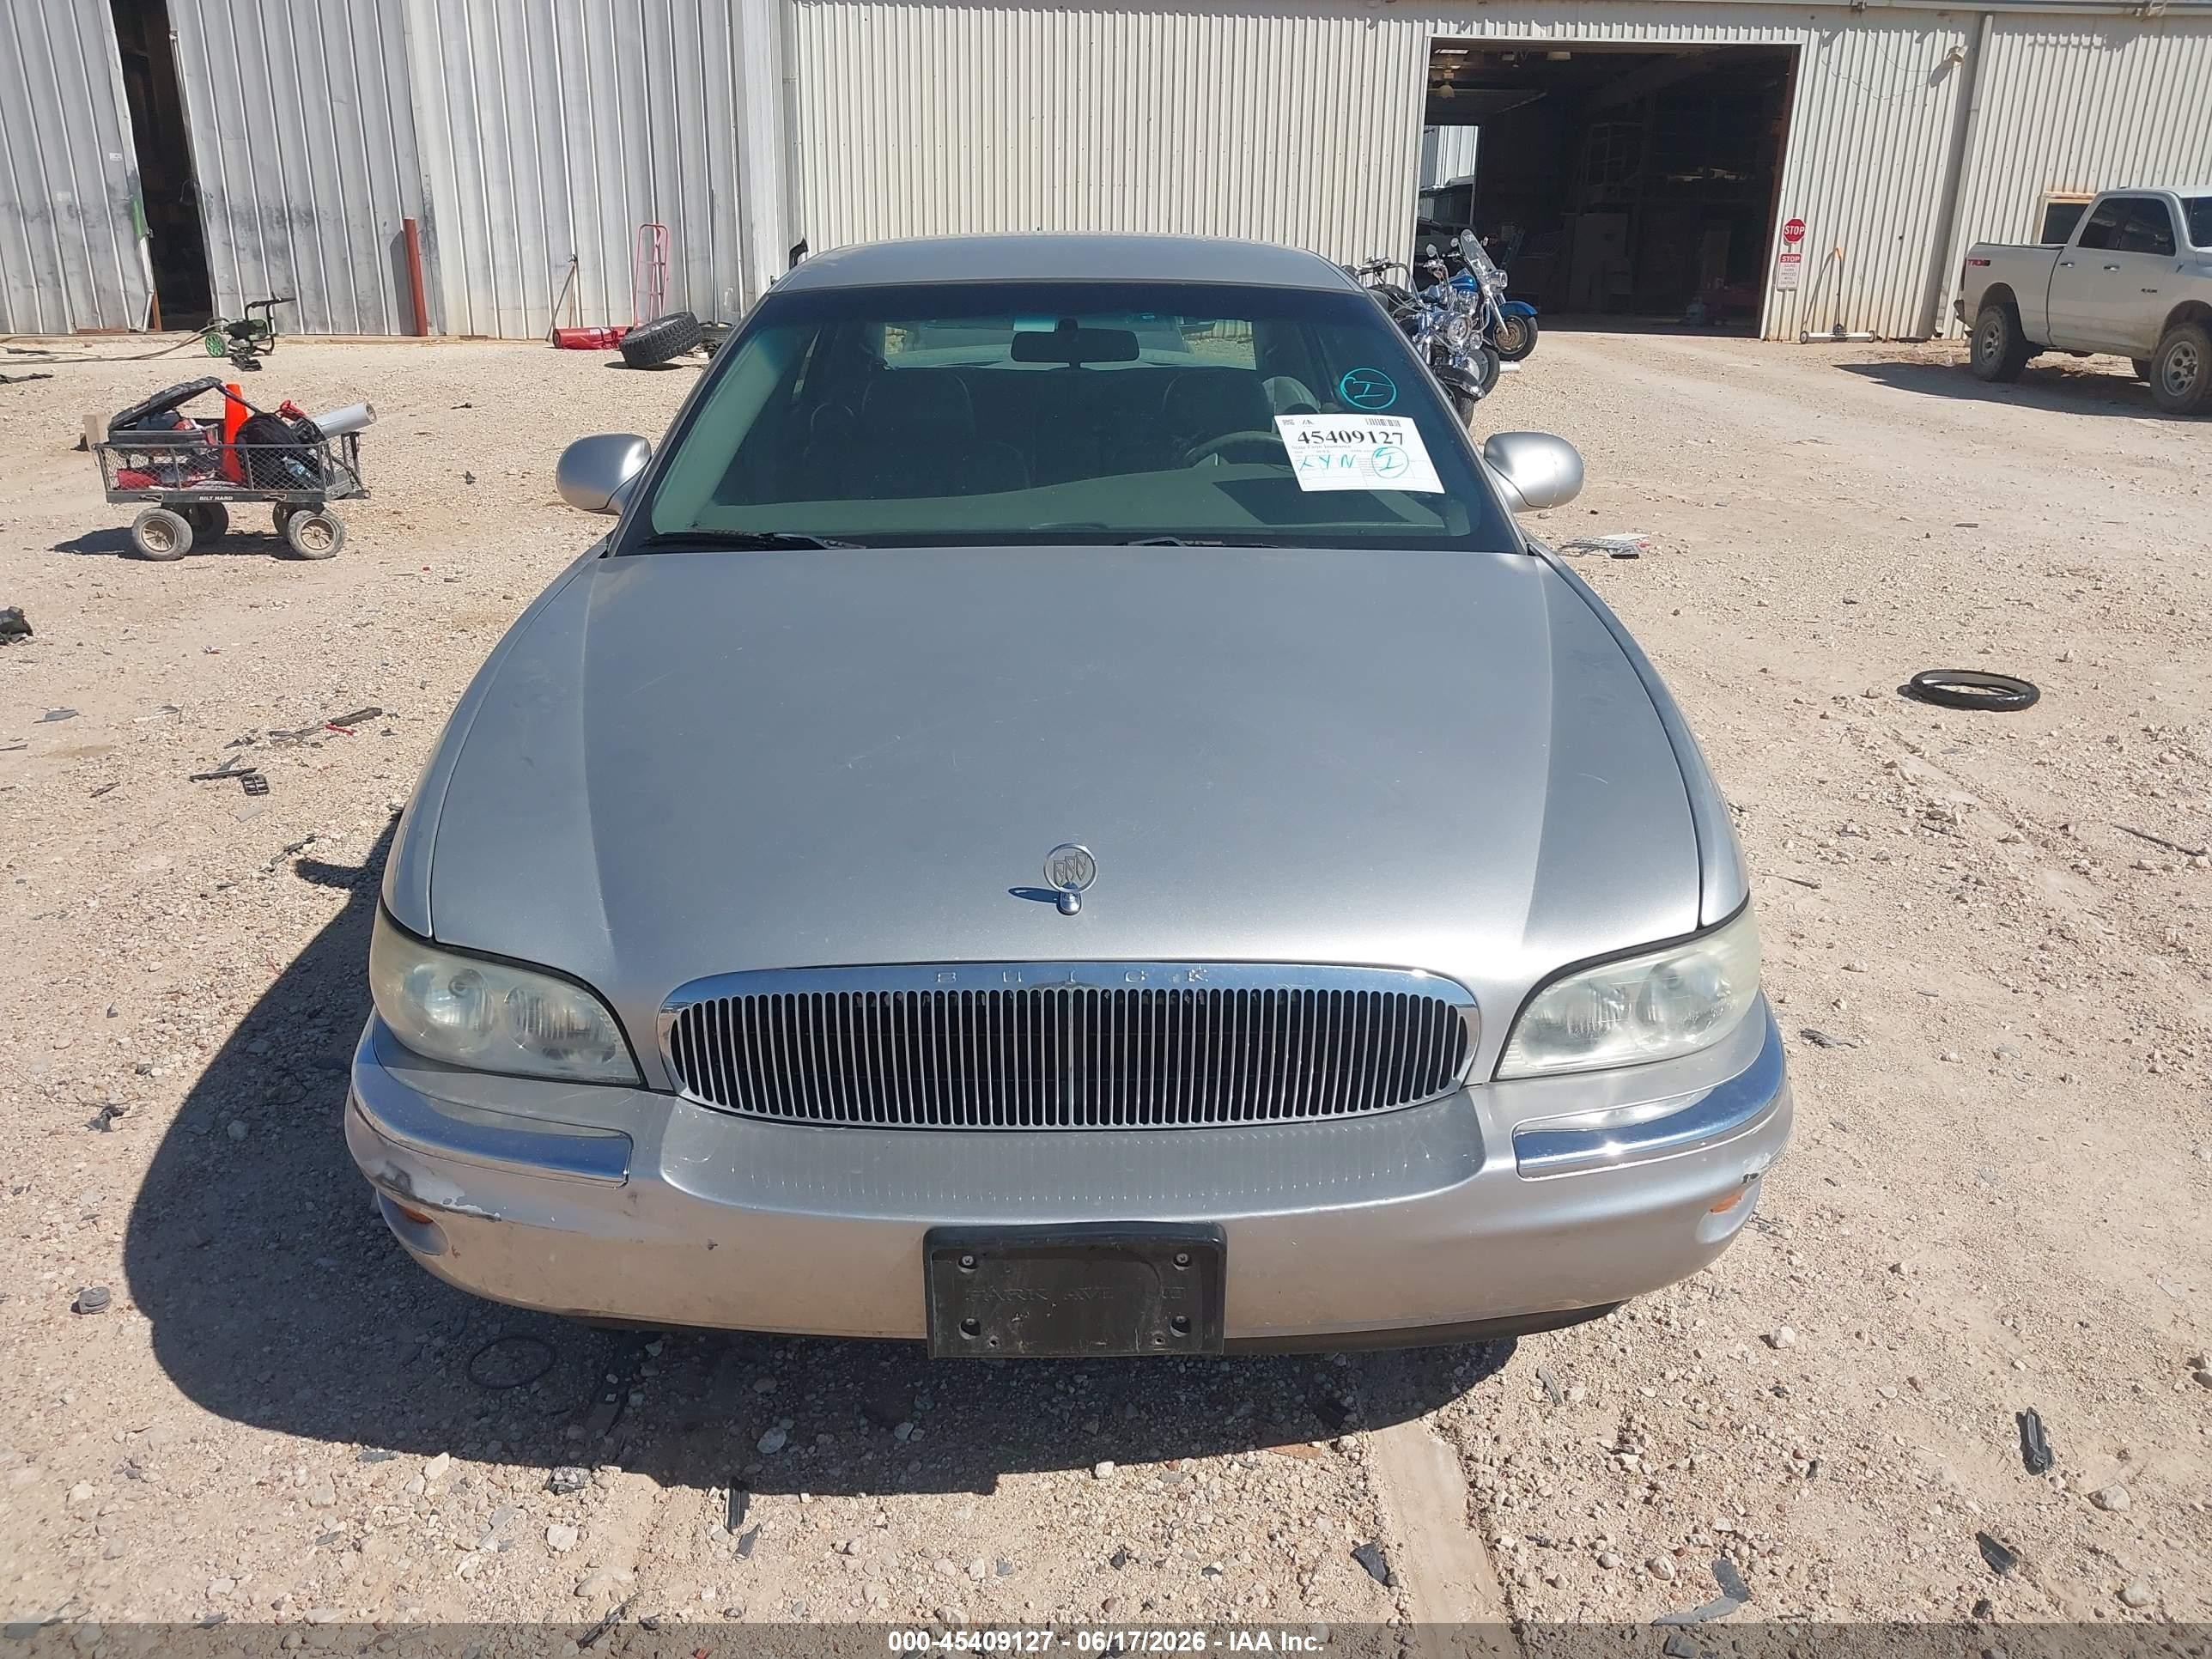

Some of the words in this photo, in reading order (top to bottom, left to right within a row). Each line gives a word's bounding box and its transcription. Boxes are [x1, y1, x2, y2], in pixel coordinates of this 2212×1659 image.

[1784, 226, 1805, 235] STOP
[1297, 430, 1403, 446] 45409127
[937, 968, 1209, 983] BUICK
